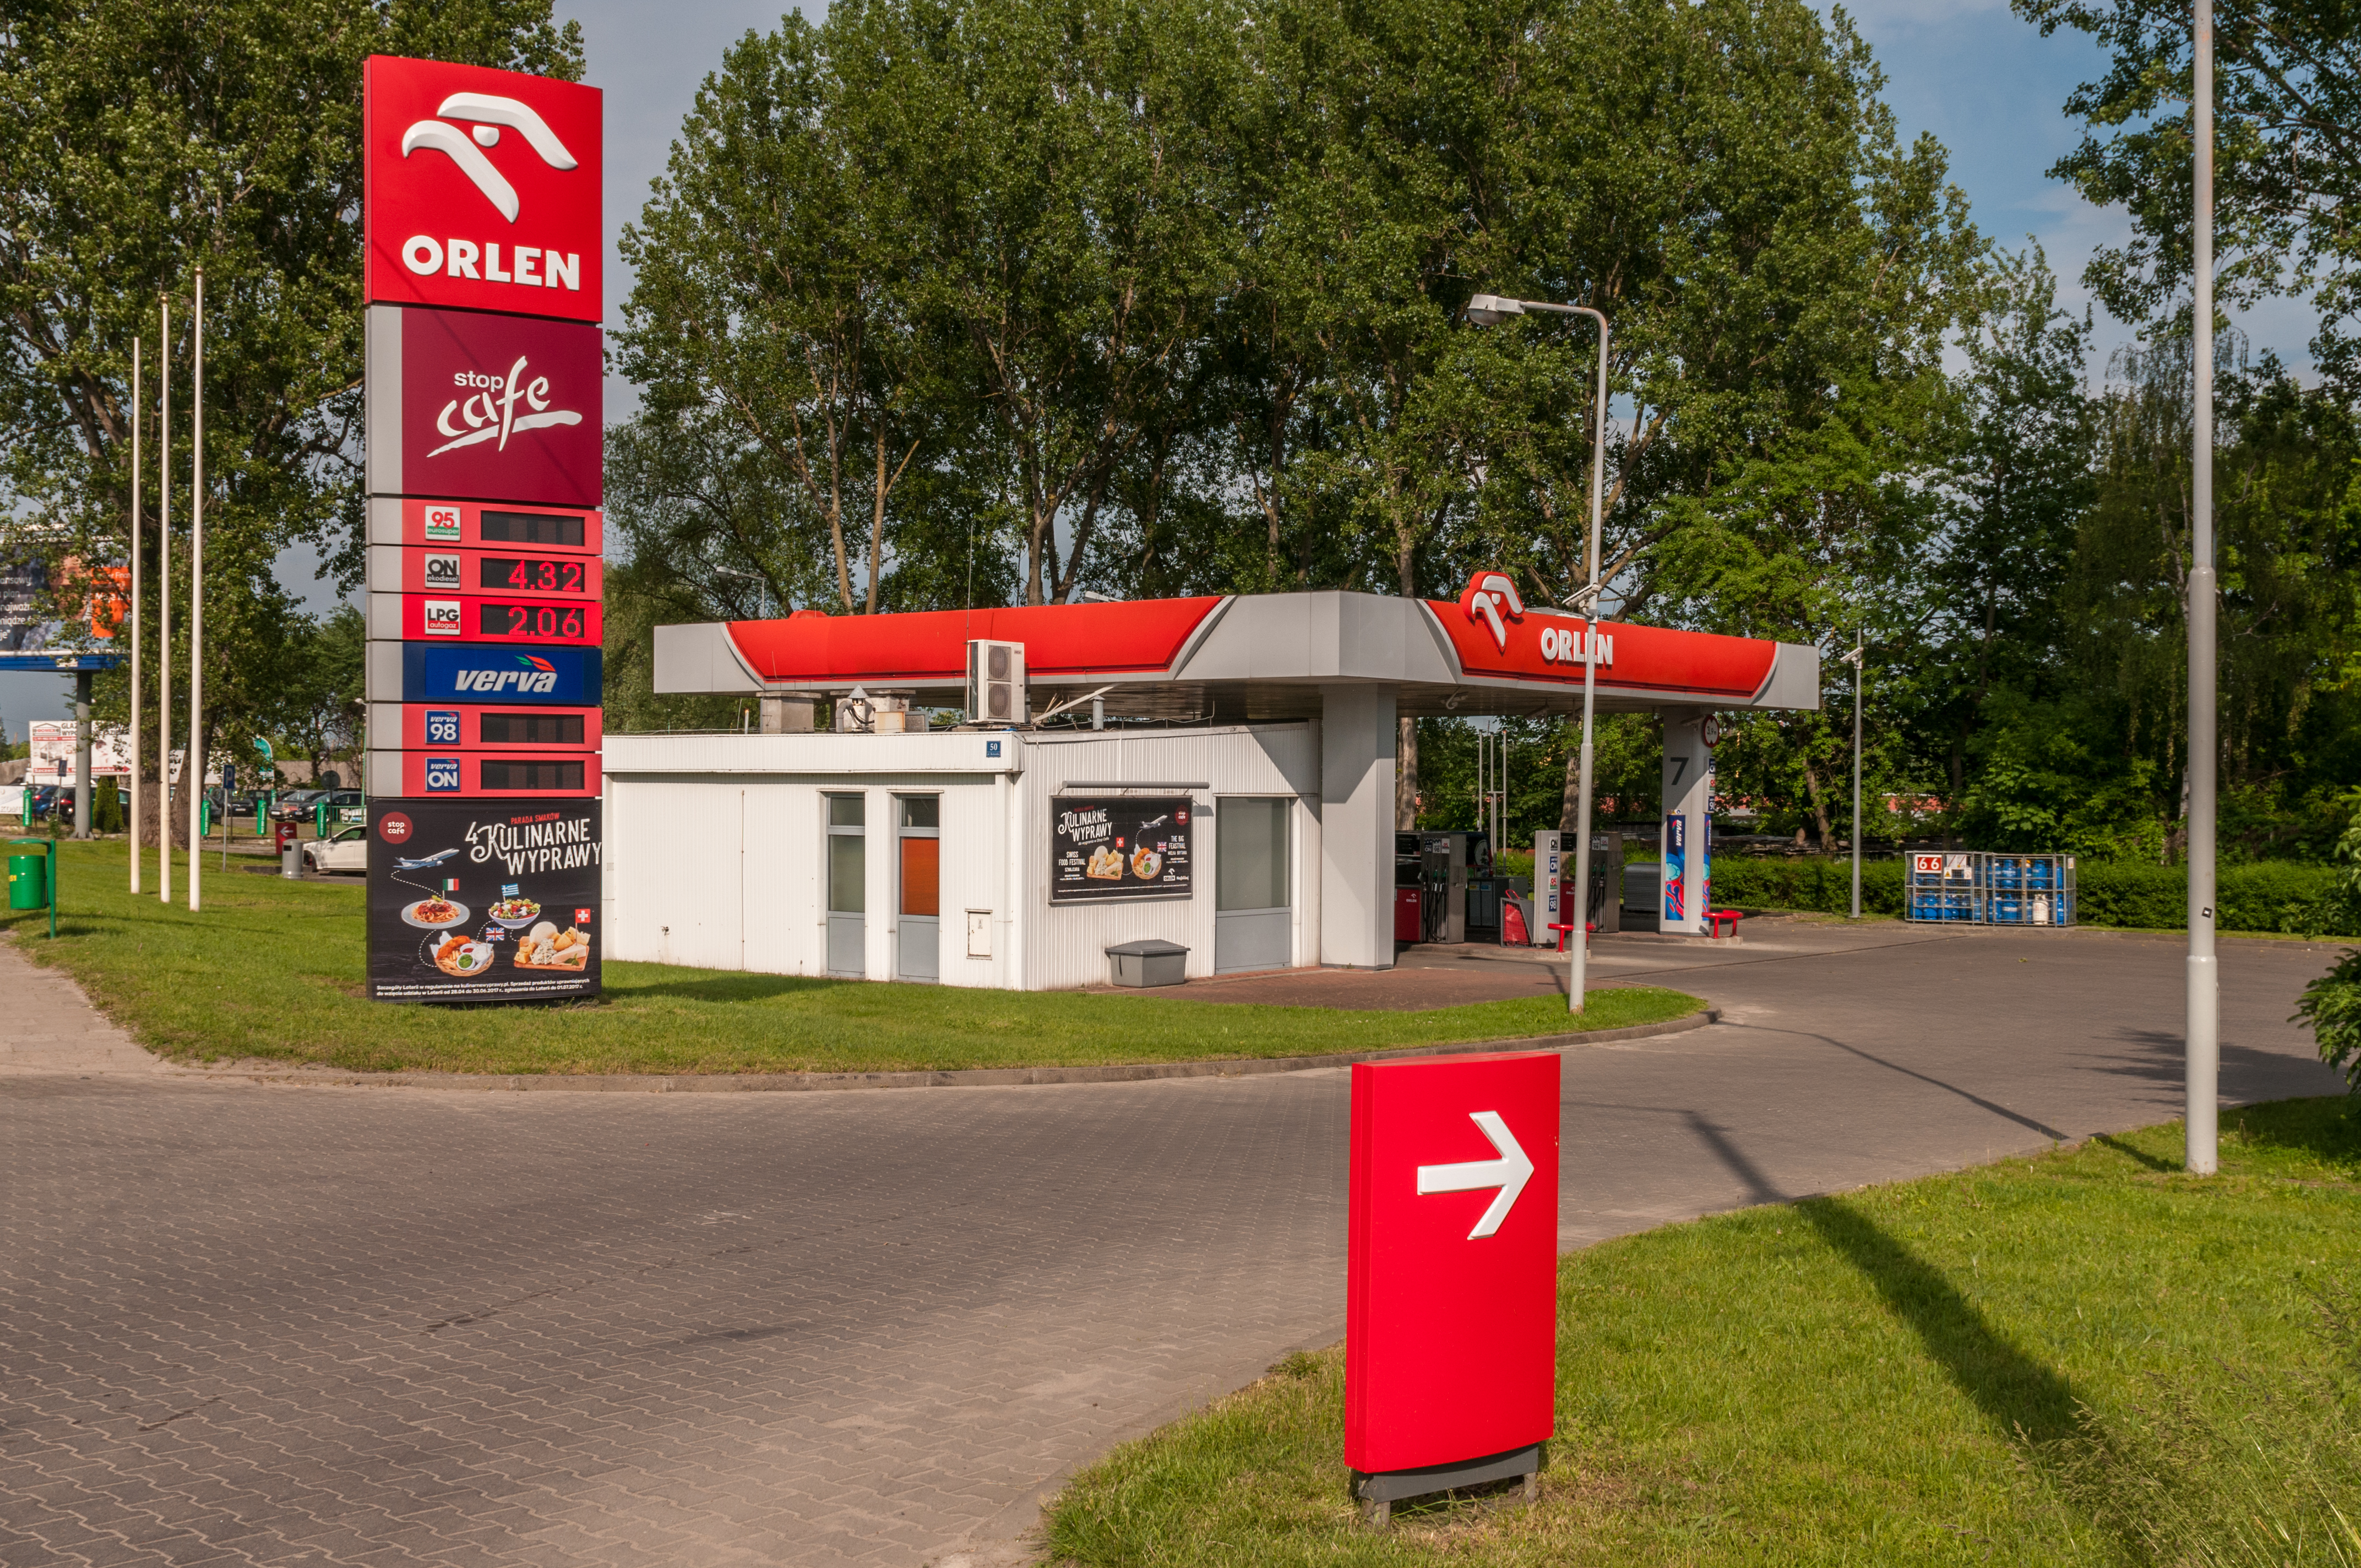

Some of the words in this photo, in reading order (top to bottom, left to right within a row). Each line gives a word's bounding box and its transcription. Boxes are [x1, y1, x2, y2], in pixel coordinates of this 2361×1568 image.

[402, 235, 580, 291] ORLEN
[454, 371, 504, 393] stop
[437, 356, 550, 451] cafe
[432, 511, 454, 529] 95
[428, 559, 457, 576] ON
[509, 560, 581, 592] 4.32
[427, 608, 459, 622] LPG
[509, 607, 581, 637] 2.06
[455, 670, 558, 693] verva
[430, 723, 456, 741] 98
[226, 767, 232, 786] P
[428, 771, 458, 787] ON
[1671, 757, 1689, 785] 7
[510, 816, 533, 825] PARADA
[1058, 808, 1107, 834] KULINARNE
[470, 818, 590, 863] KULINARNE
[1072, 822, 1112, 842] WYPRAWY
[507, 842, 602, 875] WYPRAWY
[1550, 901, 1557, 910] 98
